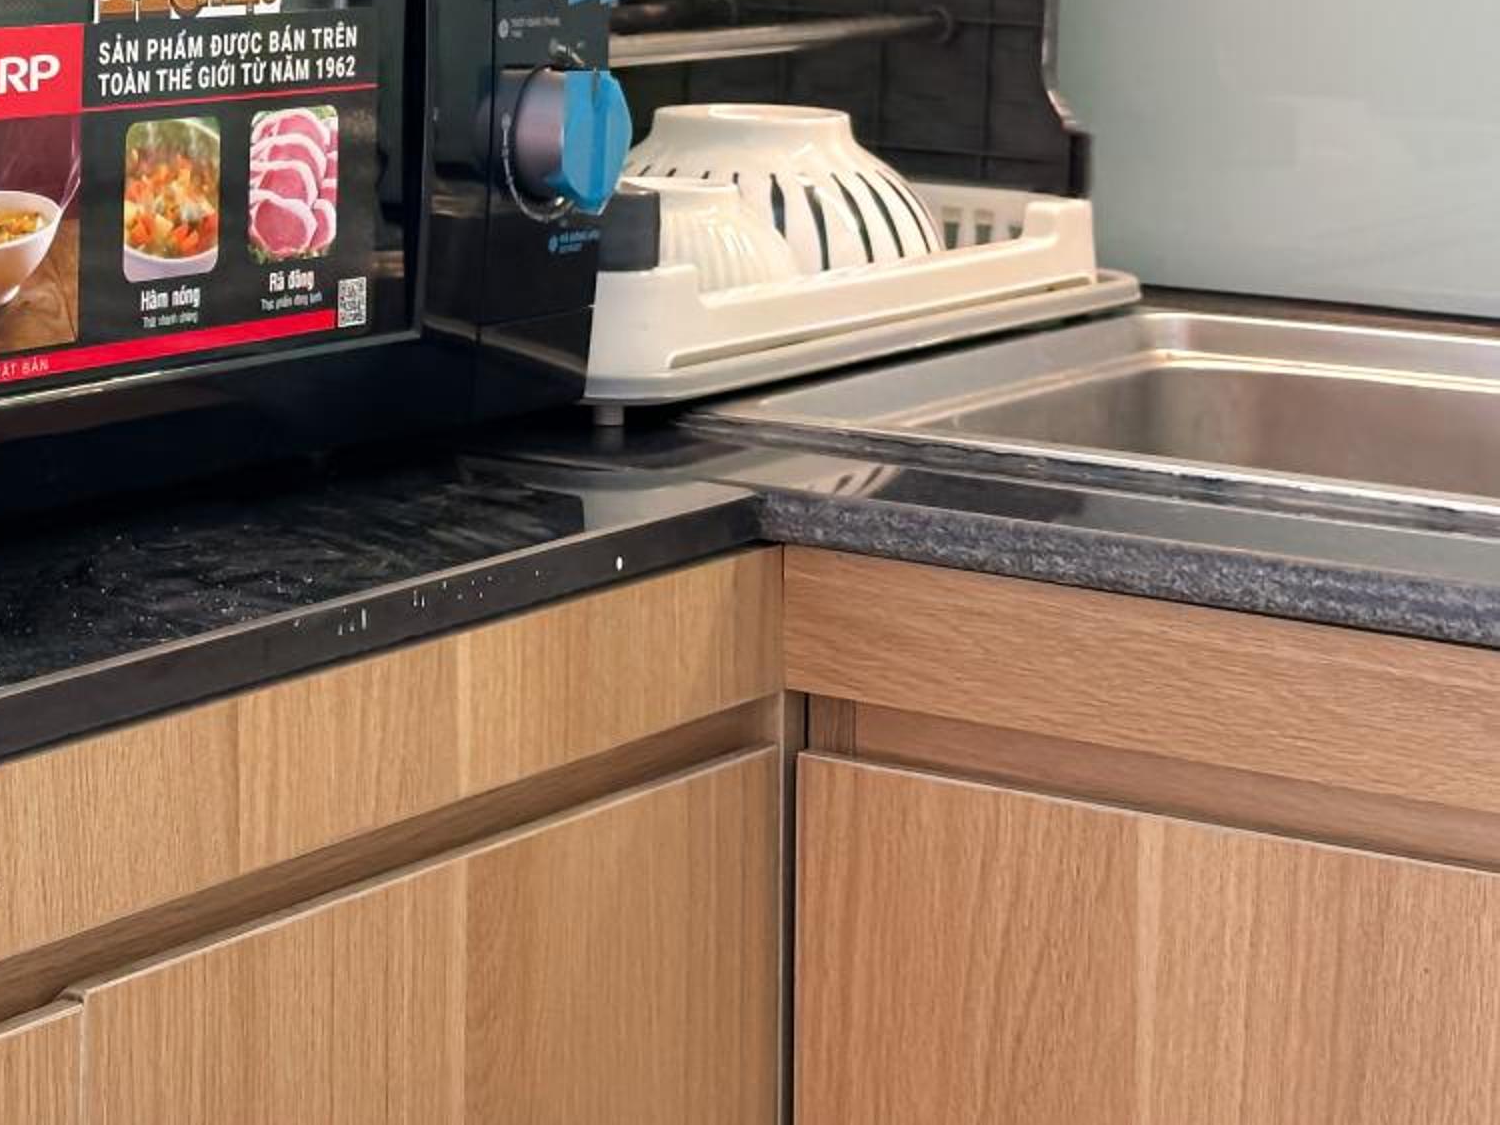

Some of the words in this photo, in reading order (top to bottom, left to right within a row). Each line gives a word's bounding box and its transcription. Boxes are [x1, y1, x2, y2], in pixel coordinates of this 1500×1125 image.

[98, 33, 140, 65] SẢN
[210, 31, 263, 60] ĐƯỢC
[268, 24, 306, 53] BÁN
[312, 21, 358, 49] TRÊN
[98, 66, 151, 97] TOÀN
[156, 60, 195, 91] THẾ
[198, 58, 235, 88] GIỚI
[241, 56, 268, 85] TỪ
[270, 53, 309, 82] NĂM
[315, 56, 356, 79] 1962
